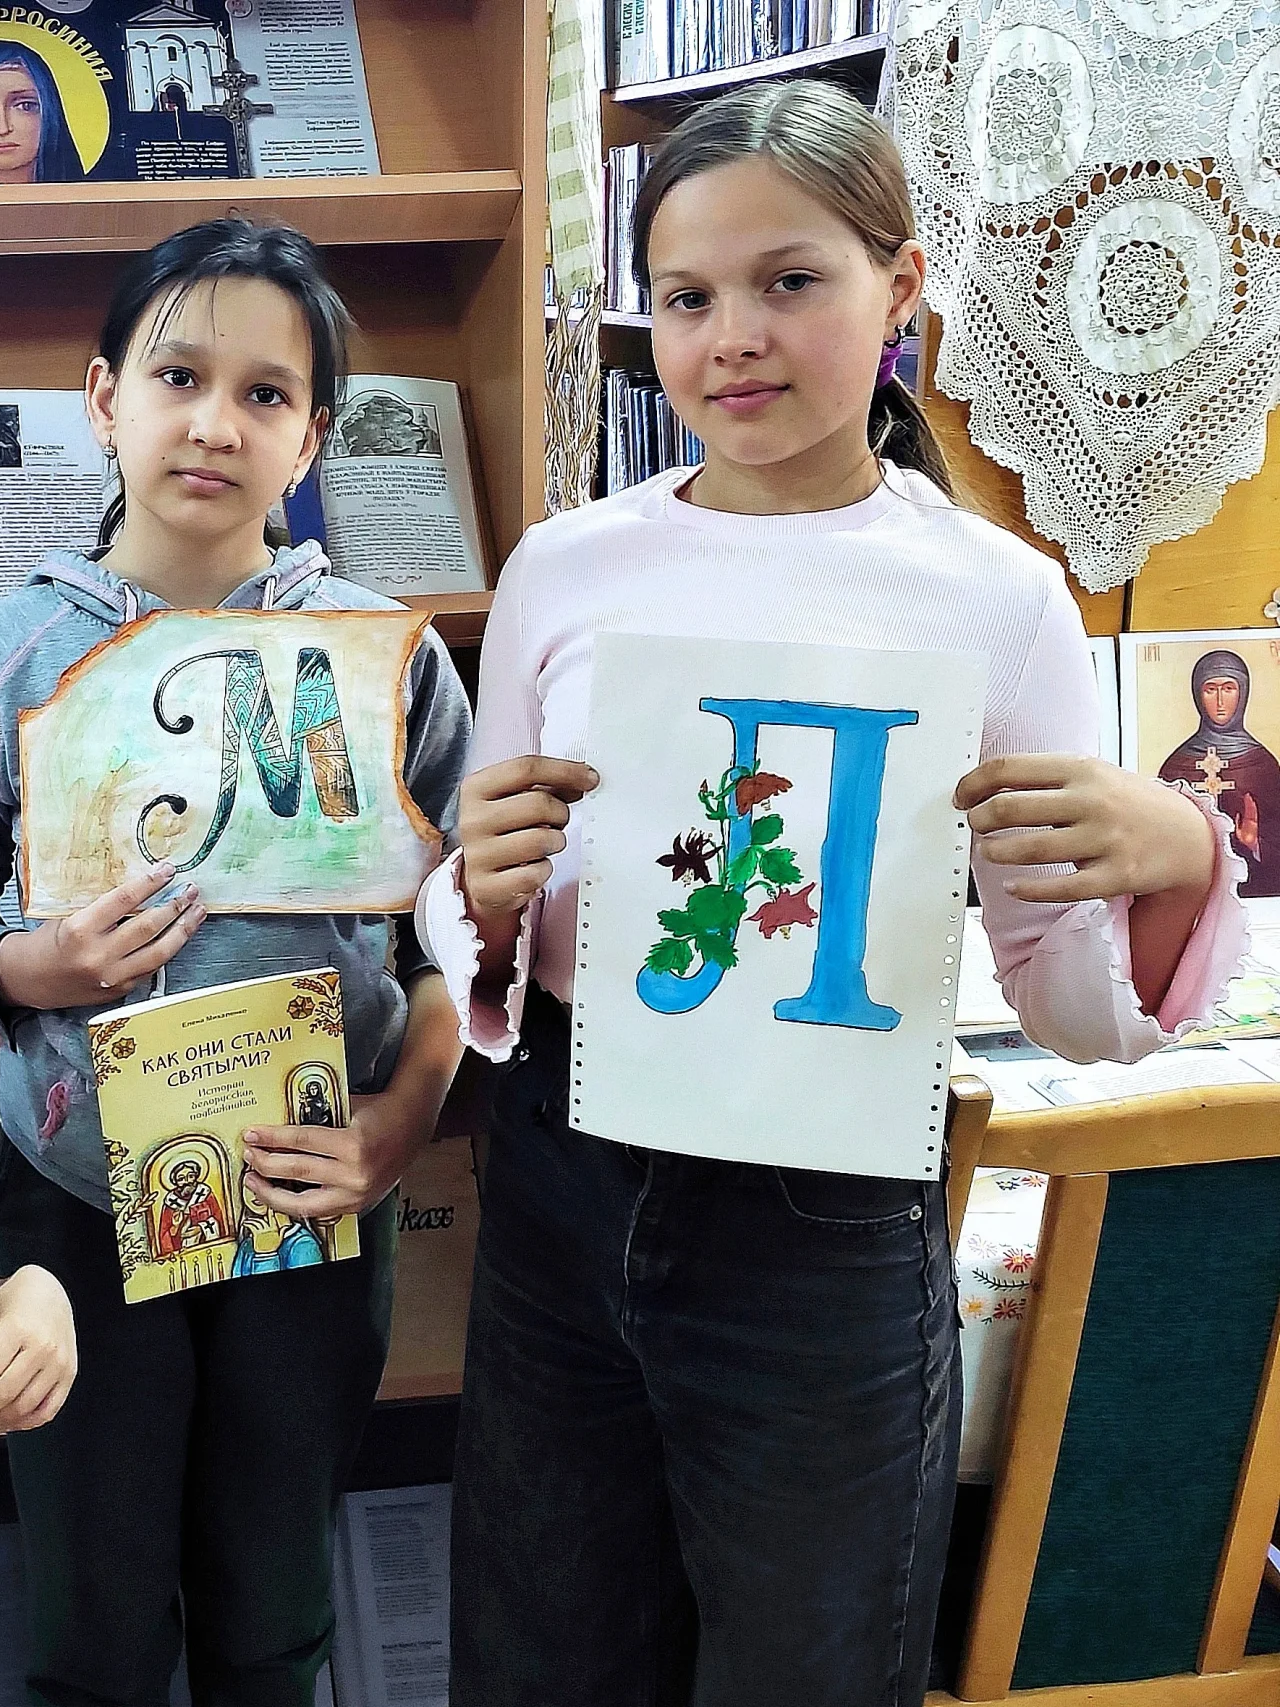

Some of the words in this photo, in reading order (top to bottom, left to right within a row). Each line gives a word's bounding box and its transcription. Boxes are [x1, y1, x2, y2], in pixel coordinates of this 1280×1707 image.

[142, 1050, 181, 1075] КАК
[185, 1039, 224, 1061] ОНИ
[230, 1026, 293, 1050] СТАЛИ
[167, 1050, 271, 1087] СВЯТЫМИ?
[198, 1080, 244, 1097] Истории
